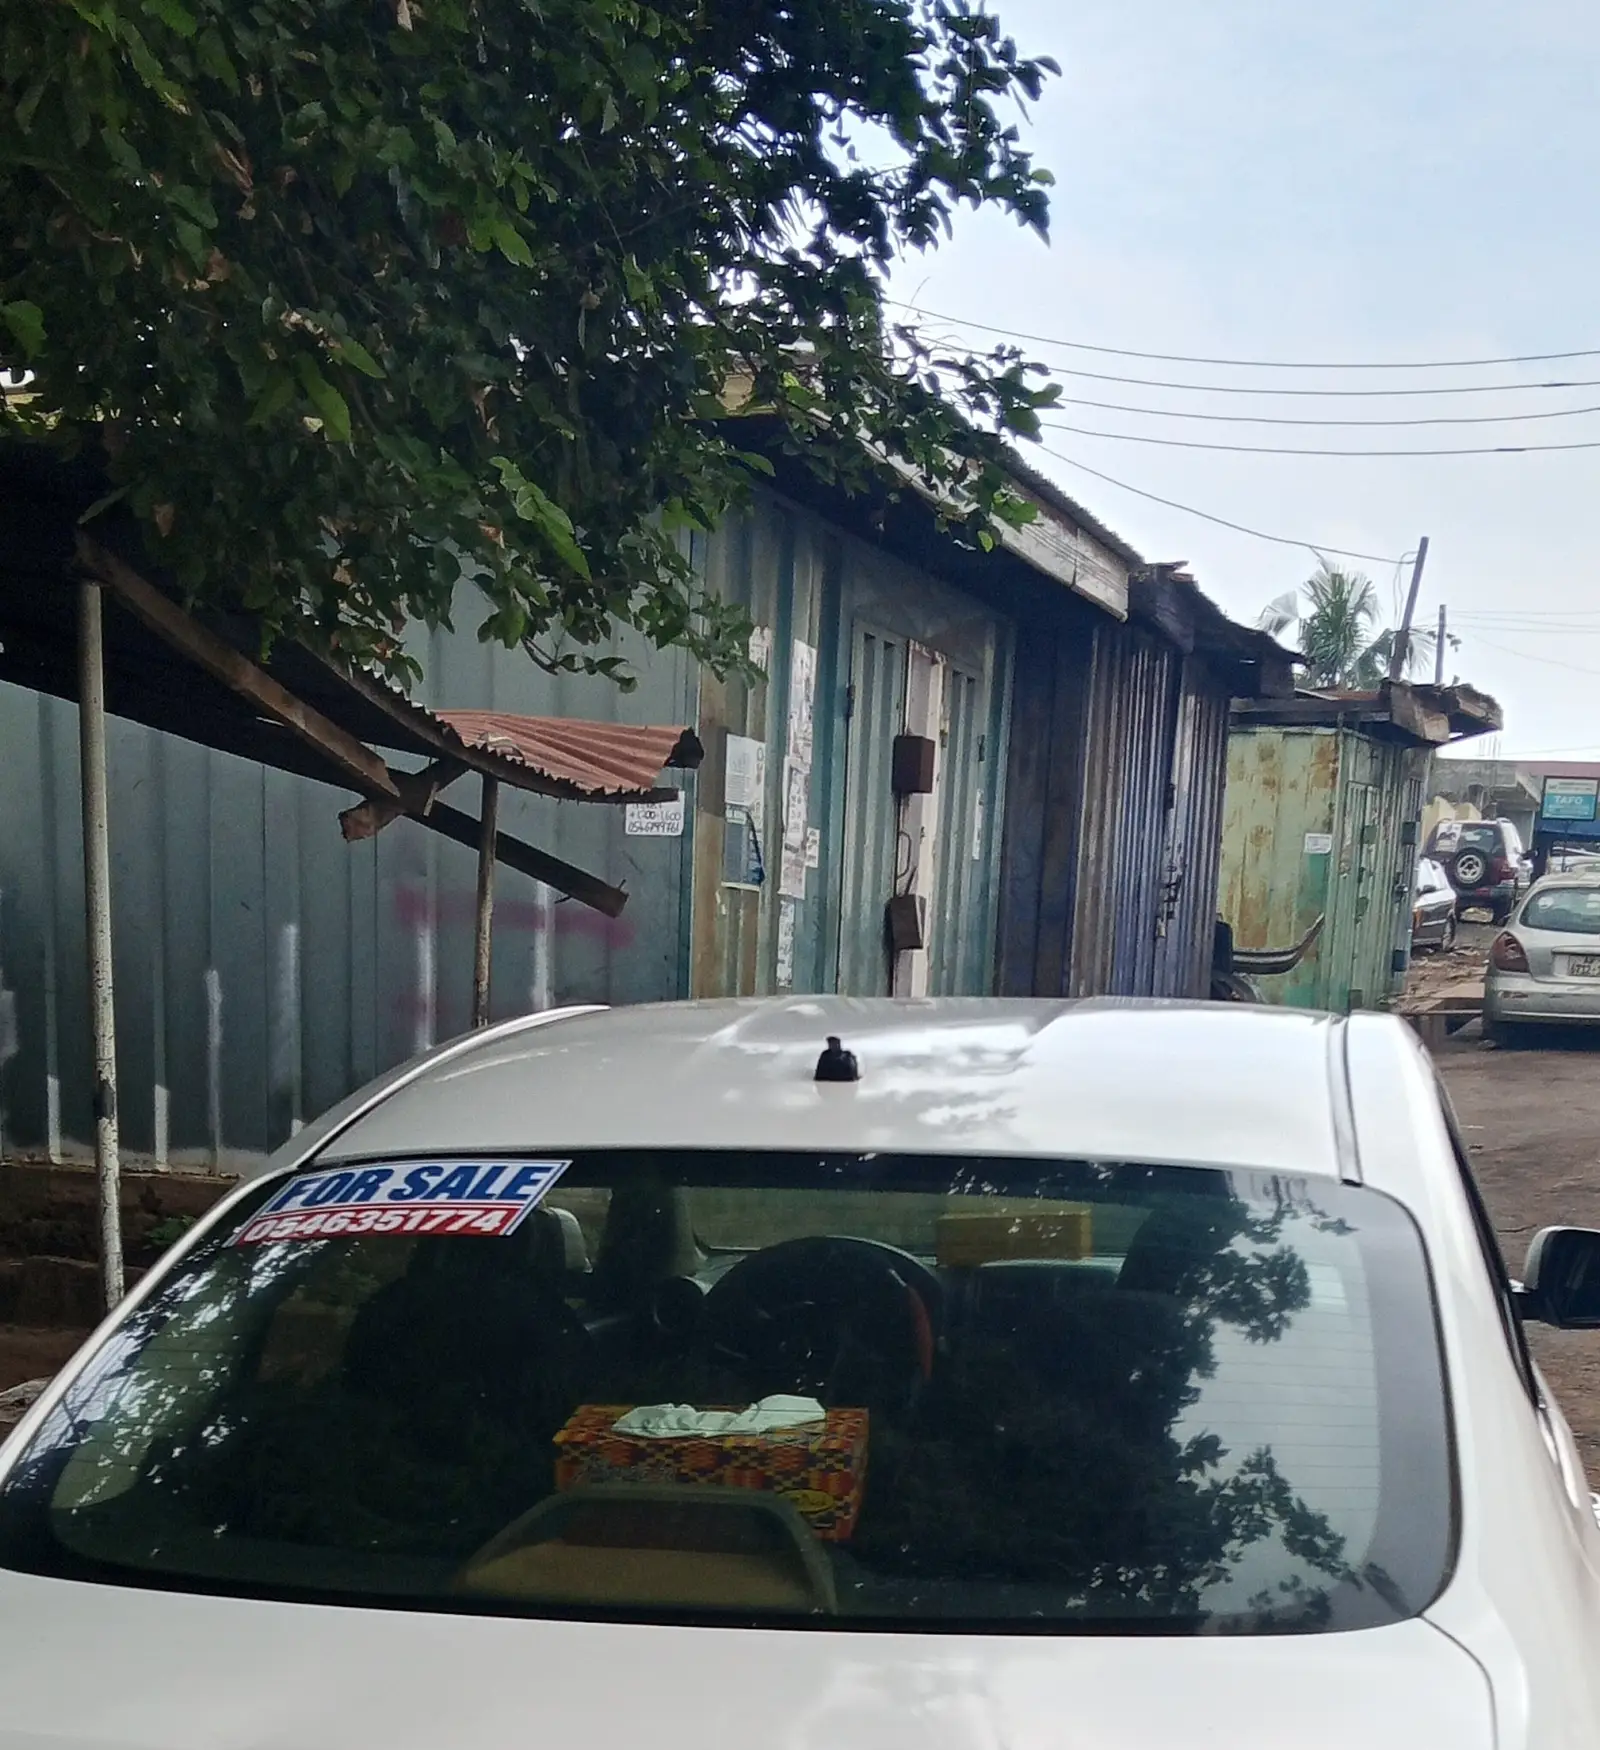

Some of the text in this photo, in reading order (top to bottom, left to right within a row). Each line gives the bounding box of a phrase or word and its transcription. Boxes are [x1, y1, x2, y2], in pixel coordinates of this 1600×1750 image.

[1553, 795, 1584, 805] TAFO
[271, 1165, 555, 1211] FOR SALE
[245, 1209, 503, 1241] 0546351774
